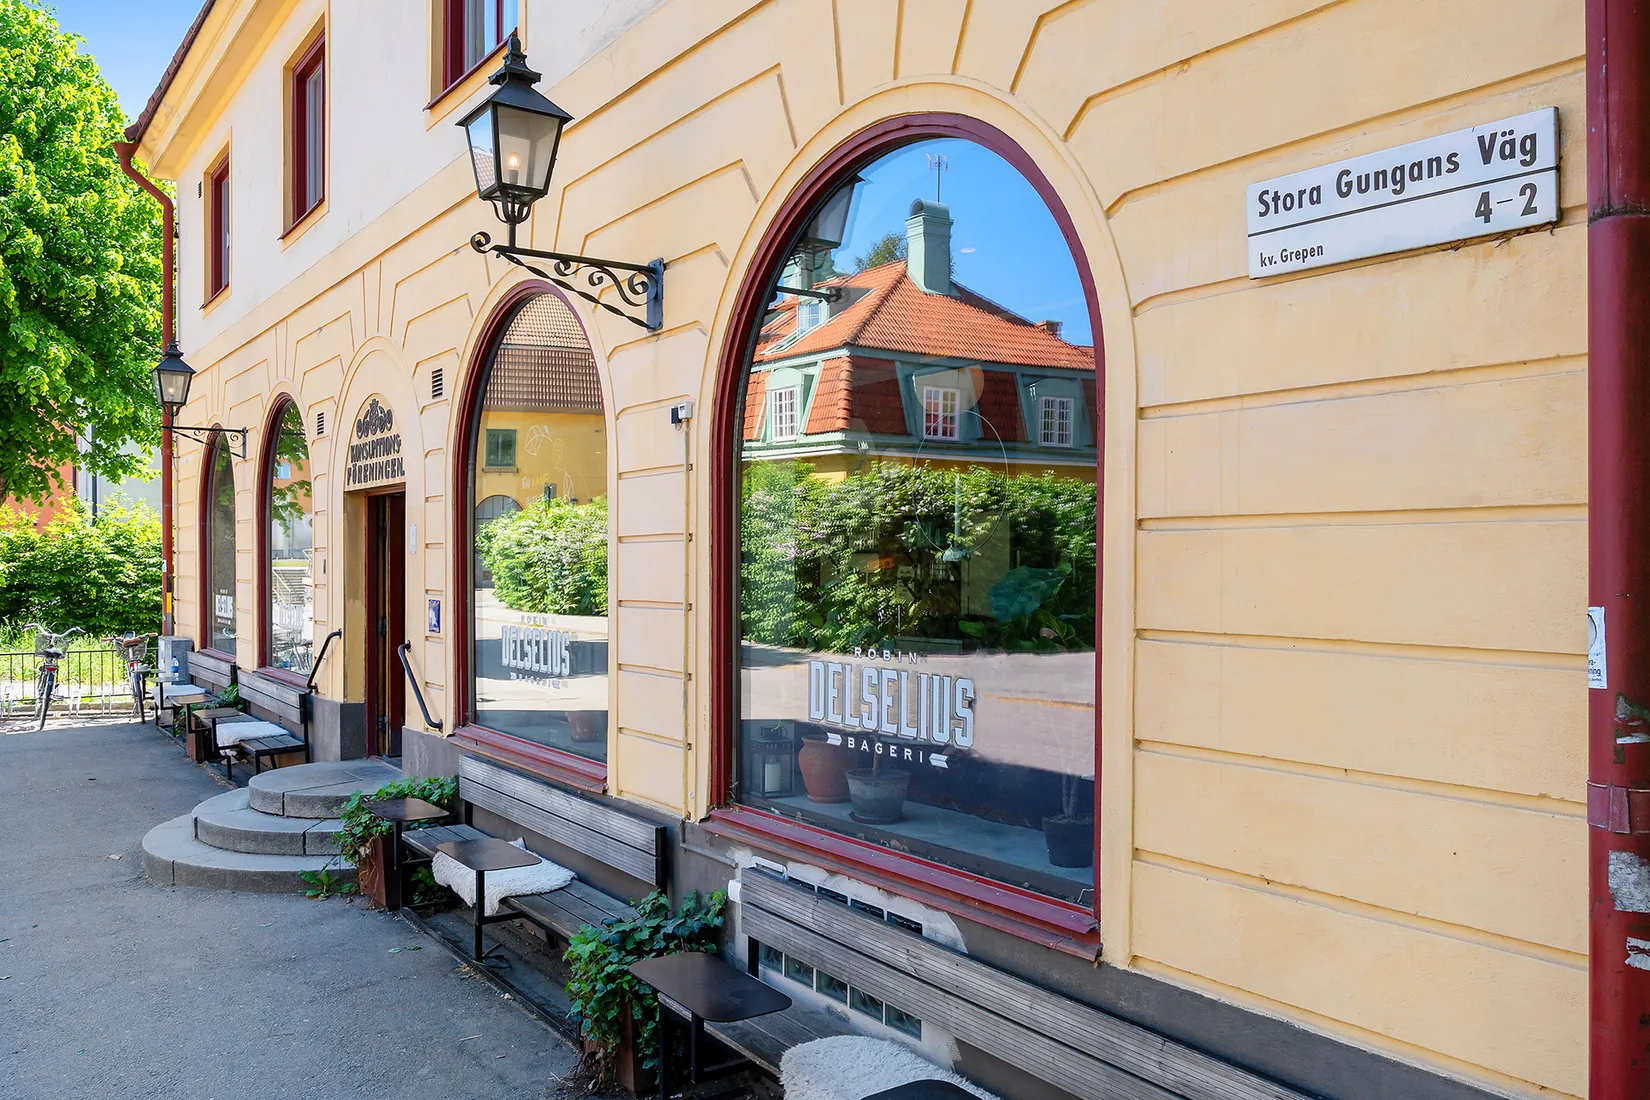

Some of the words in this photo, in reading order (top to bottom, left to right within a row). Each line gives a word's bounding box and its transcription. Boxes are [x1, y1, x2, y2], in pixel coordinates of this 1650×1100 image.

[1258, 184, 1322, 217] Stora
[1336, 151, 1460, 198] Gungans
[1477, 129, 1538, 167] Väg
[1260, 253, 1277, 267] kv.
[1280, 245, 1324, 263] Grepen
[501, 625, 570, 677] DELSELIUS
[854, 647, 917, 665] ROBIN
[808, 661, 975, 750] DELSELIUS
[848, 737, 923, 763] BAGERI
